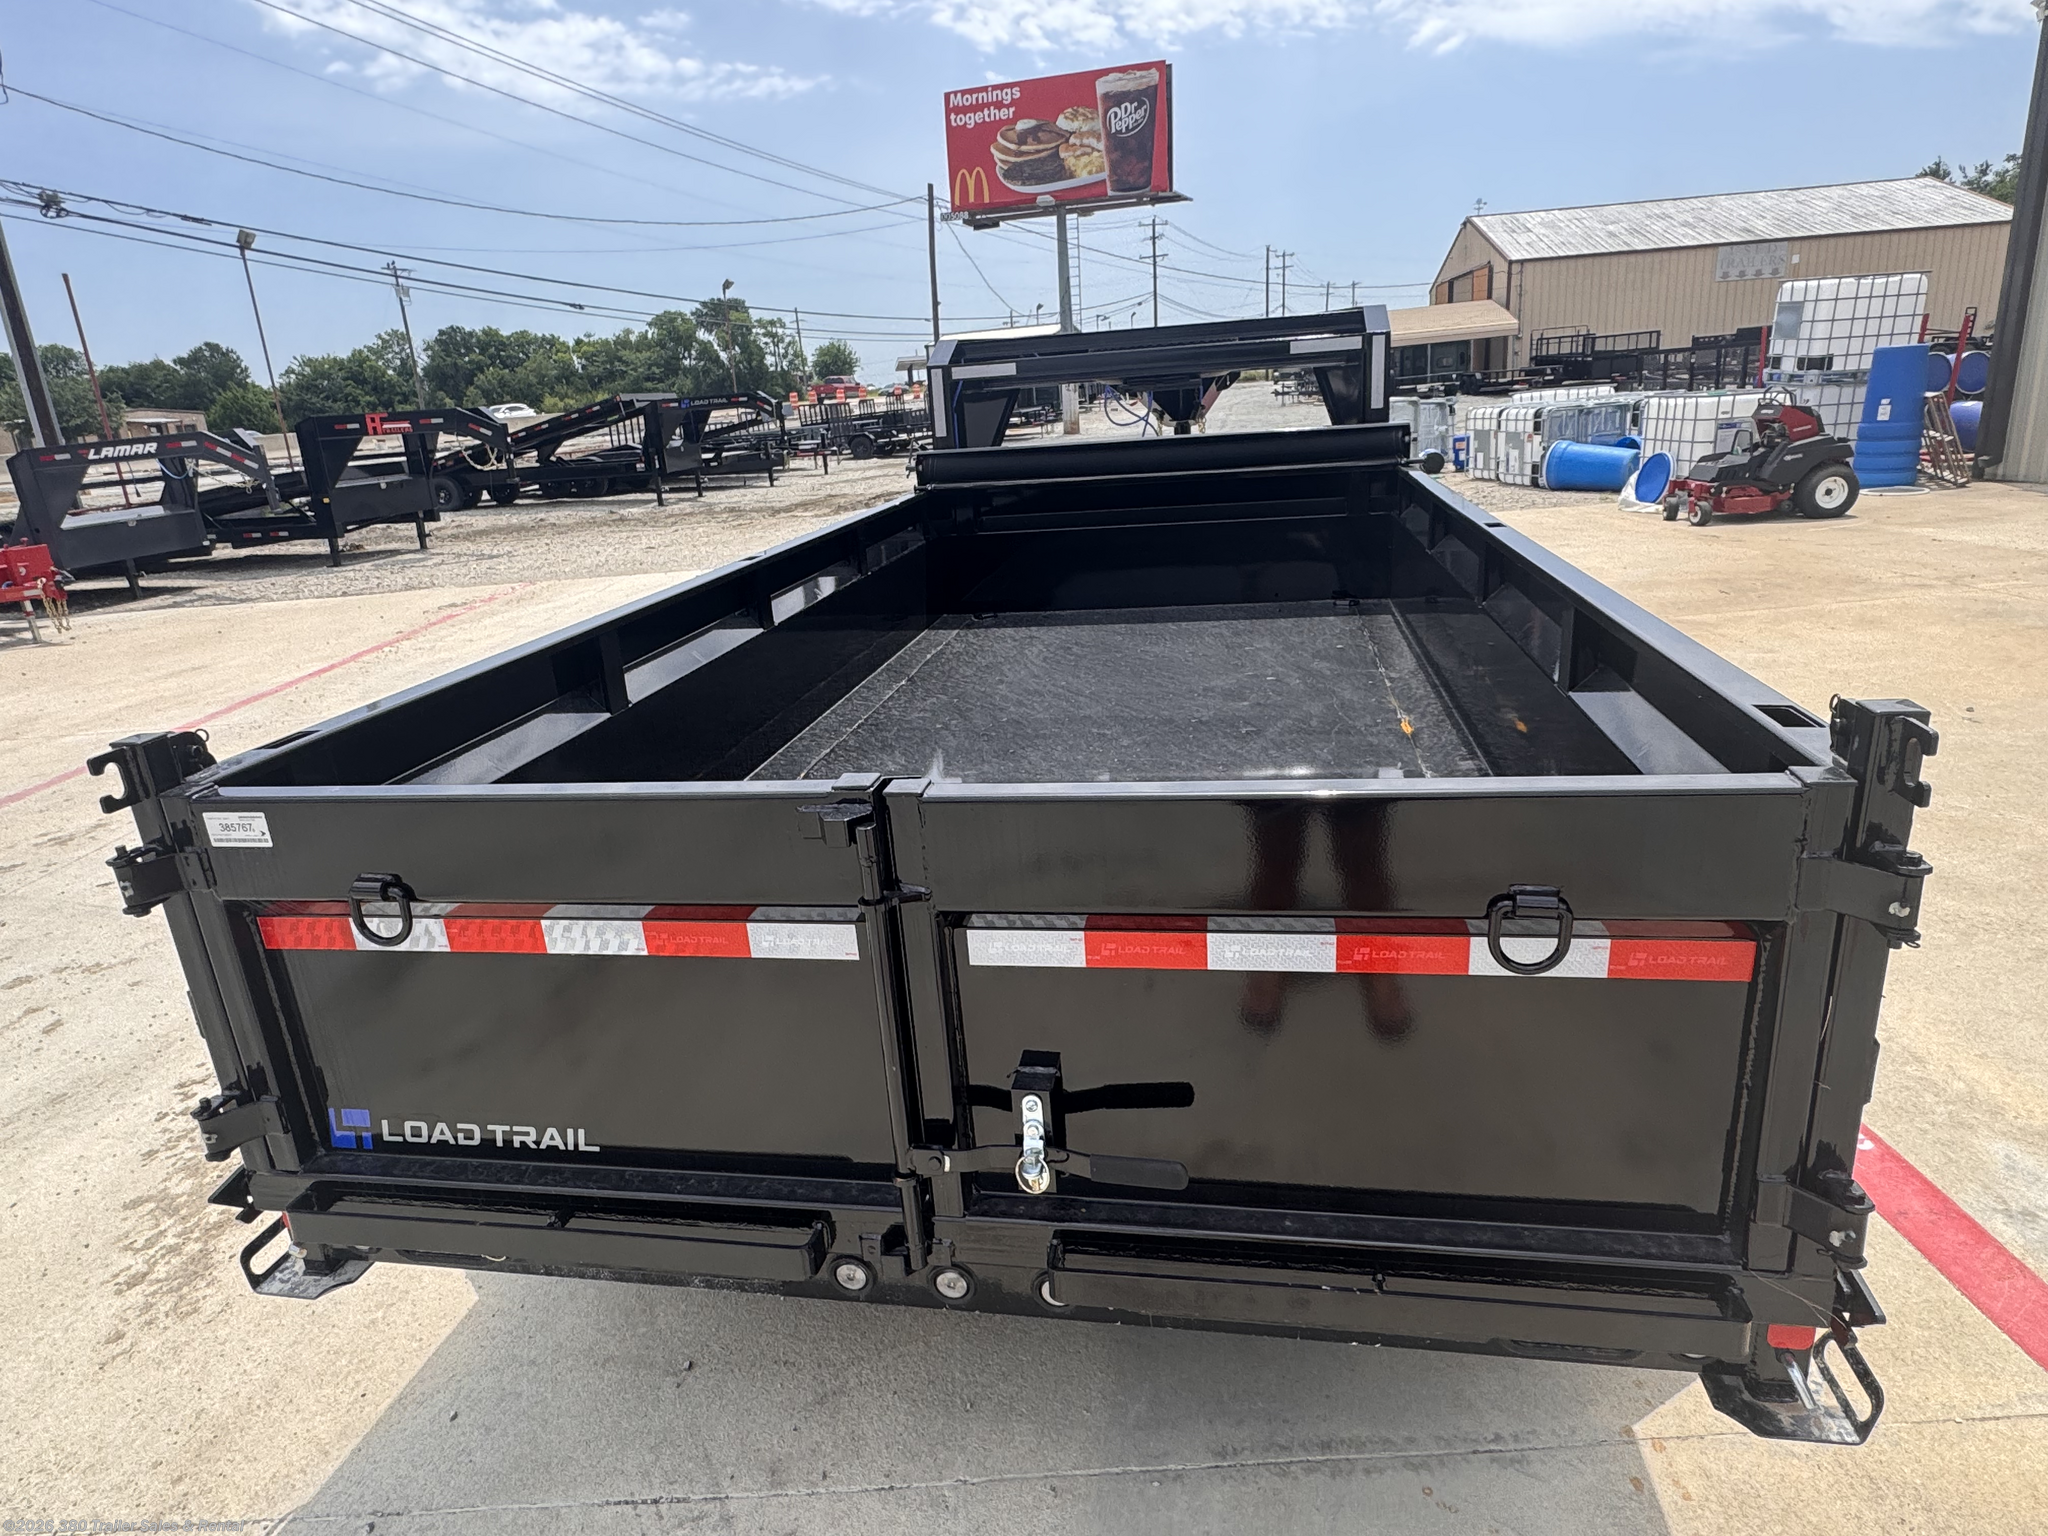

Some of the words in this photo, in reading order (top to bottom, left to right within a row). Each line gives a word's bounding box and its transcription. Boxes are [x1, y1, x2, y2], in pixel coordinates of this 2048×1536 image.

[949, 86, 1021, 109] Mornings
[949, 106, 1016, 128] together
[1120, 101, 1138, 119] Dr
[1107, 105, 1147, 134] Pepper
[1720, 253, 1786, 270] TRAILERS
[87, 442, 158, 460] LAMAR
[219, 822, 252, 833] 385767
[670, 935, 698, 944] LOAD
[698, 936, 729, 945] TRAIL
[1118, 946, 1151, 955] LOAD
[1152, 946, 1186, 955] TRAIL
[1372, 950, 1408, 959] LOAD
[1408, 951, 1446, 960] TRAIL
[1650, 955, 1688, 965] LOAD
[1688, 955, 1727, 966] TRAIL
[381, 1119, 481, 1146] LOAD
[486, 1124, 601, 1152] TRAIL
